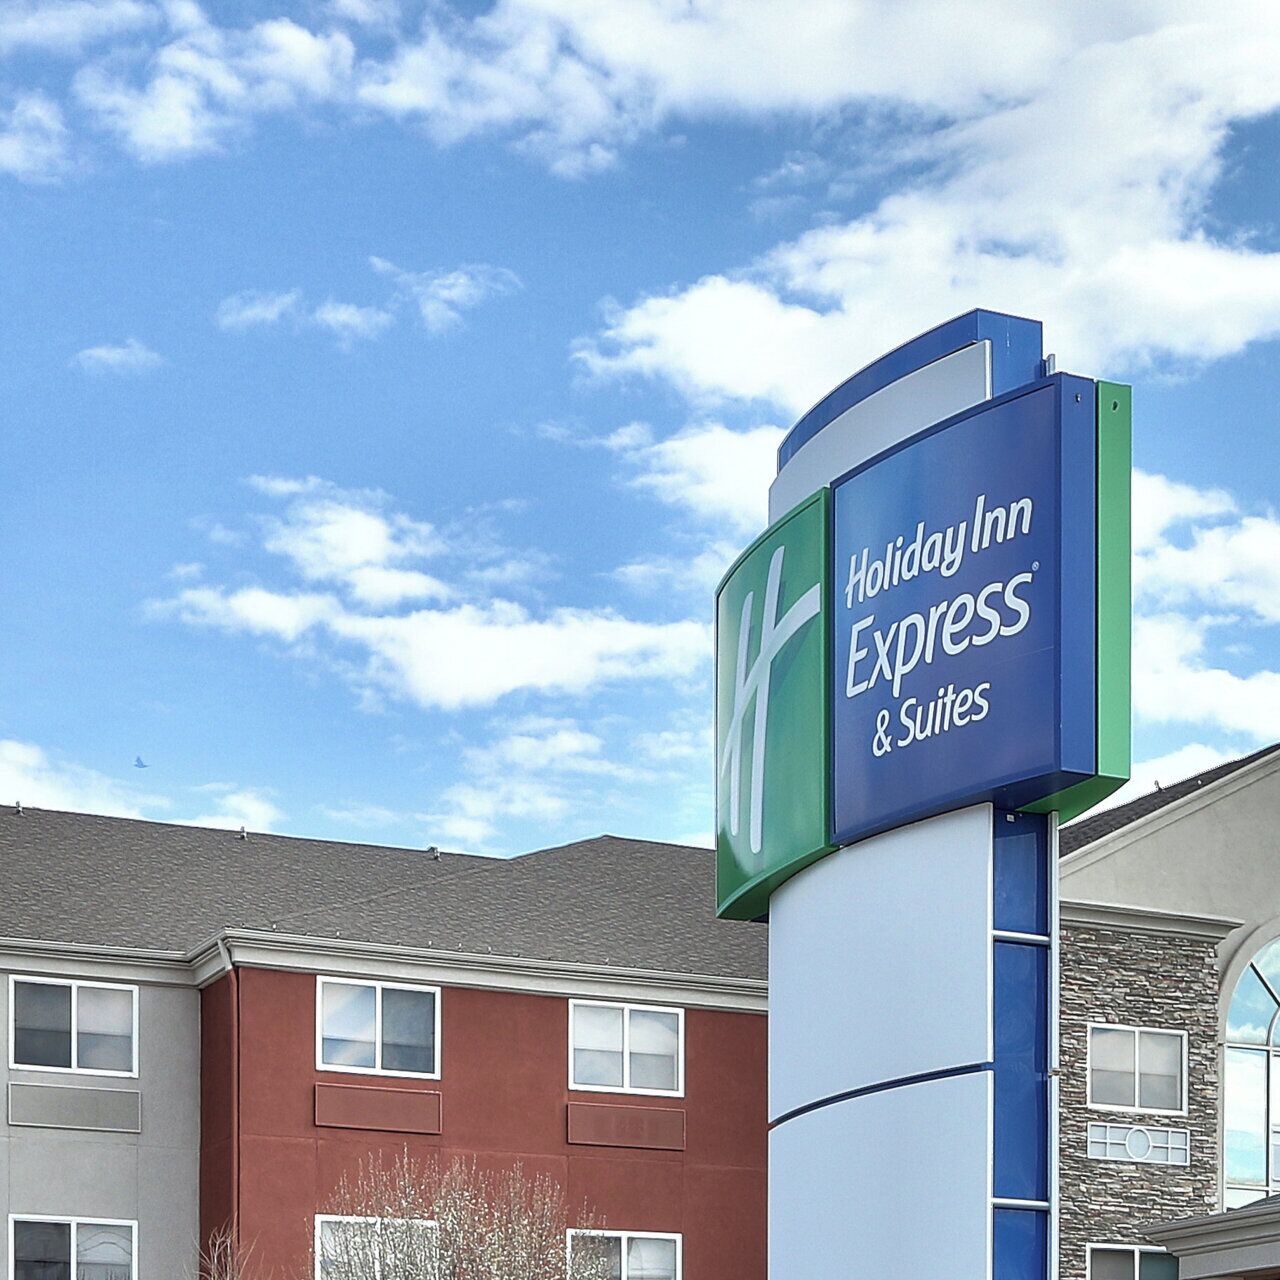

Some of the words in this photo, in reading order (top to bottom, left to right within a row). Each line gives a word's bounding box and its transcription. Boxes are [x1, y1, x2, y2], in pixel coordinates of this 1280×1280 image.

[844, 520, 968, 610] Holiday
[970, 493, 1033, 553] Inn
[871, 708, 893, 758] &
[896, 682, 991, 748] Suites
